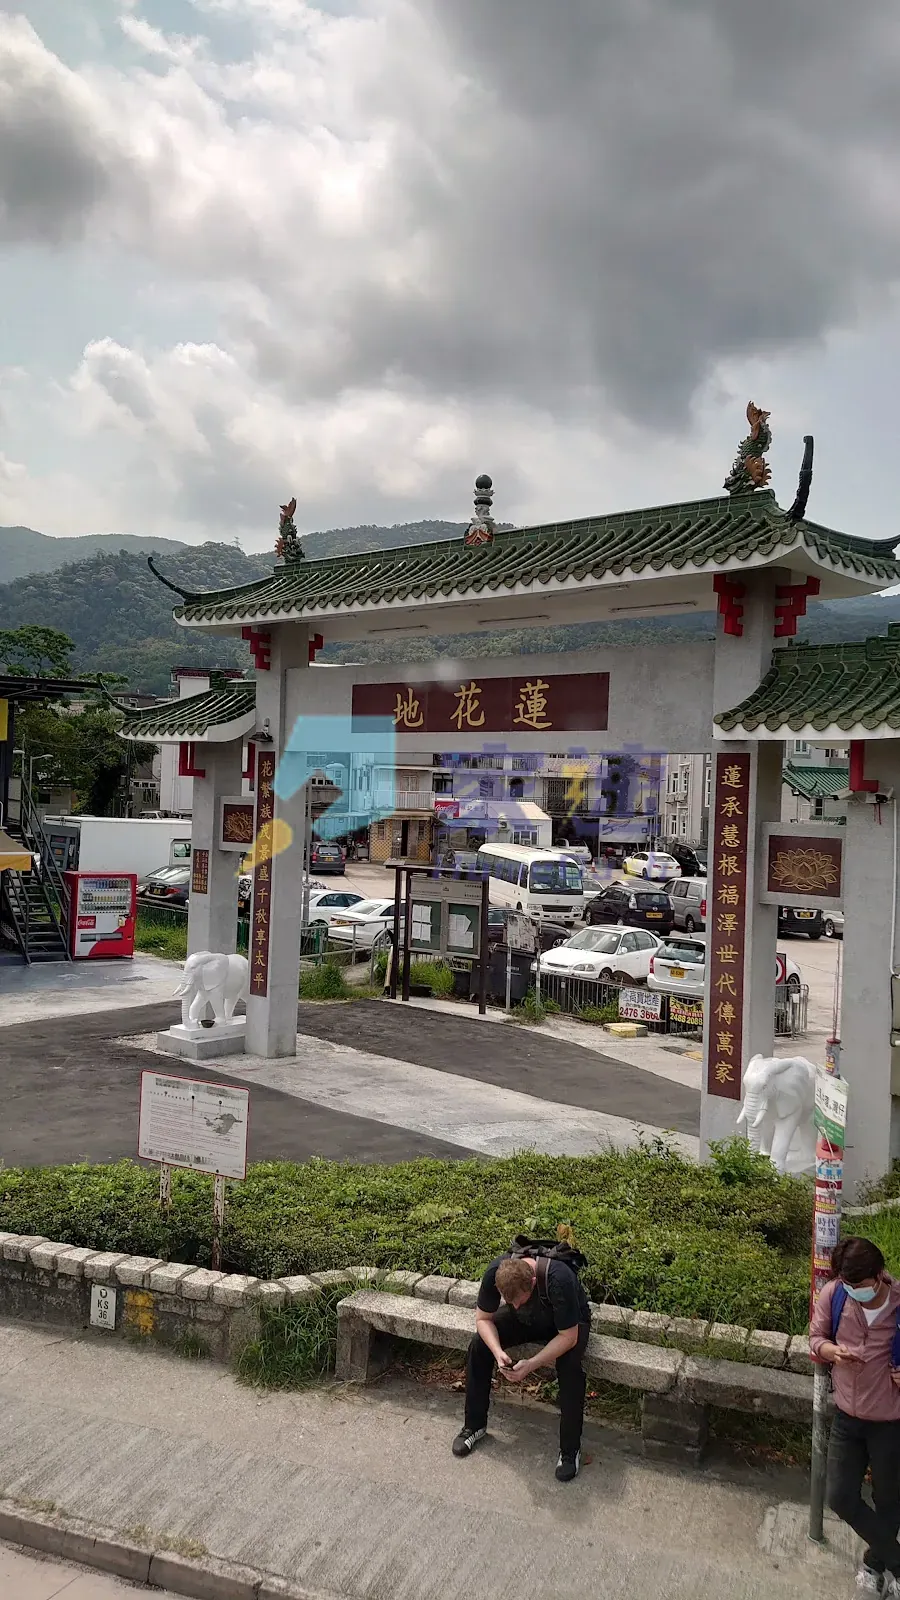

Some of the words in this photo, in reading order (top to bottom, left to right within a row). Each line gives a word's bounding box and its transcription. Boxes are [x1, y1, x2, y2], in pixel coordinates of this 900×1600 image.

[714, 765, 744, 1084] 蓮承慧根福澤世代傳萬家
[619, 1006, 638, 1018] 2476
[98, 1309, 108, 1320] 36
